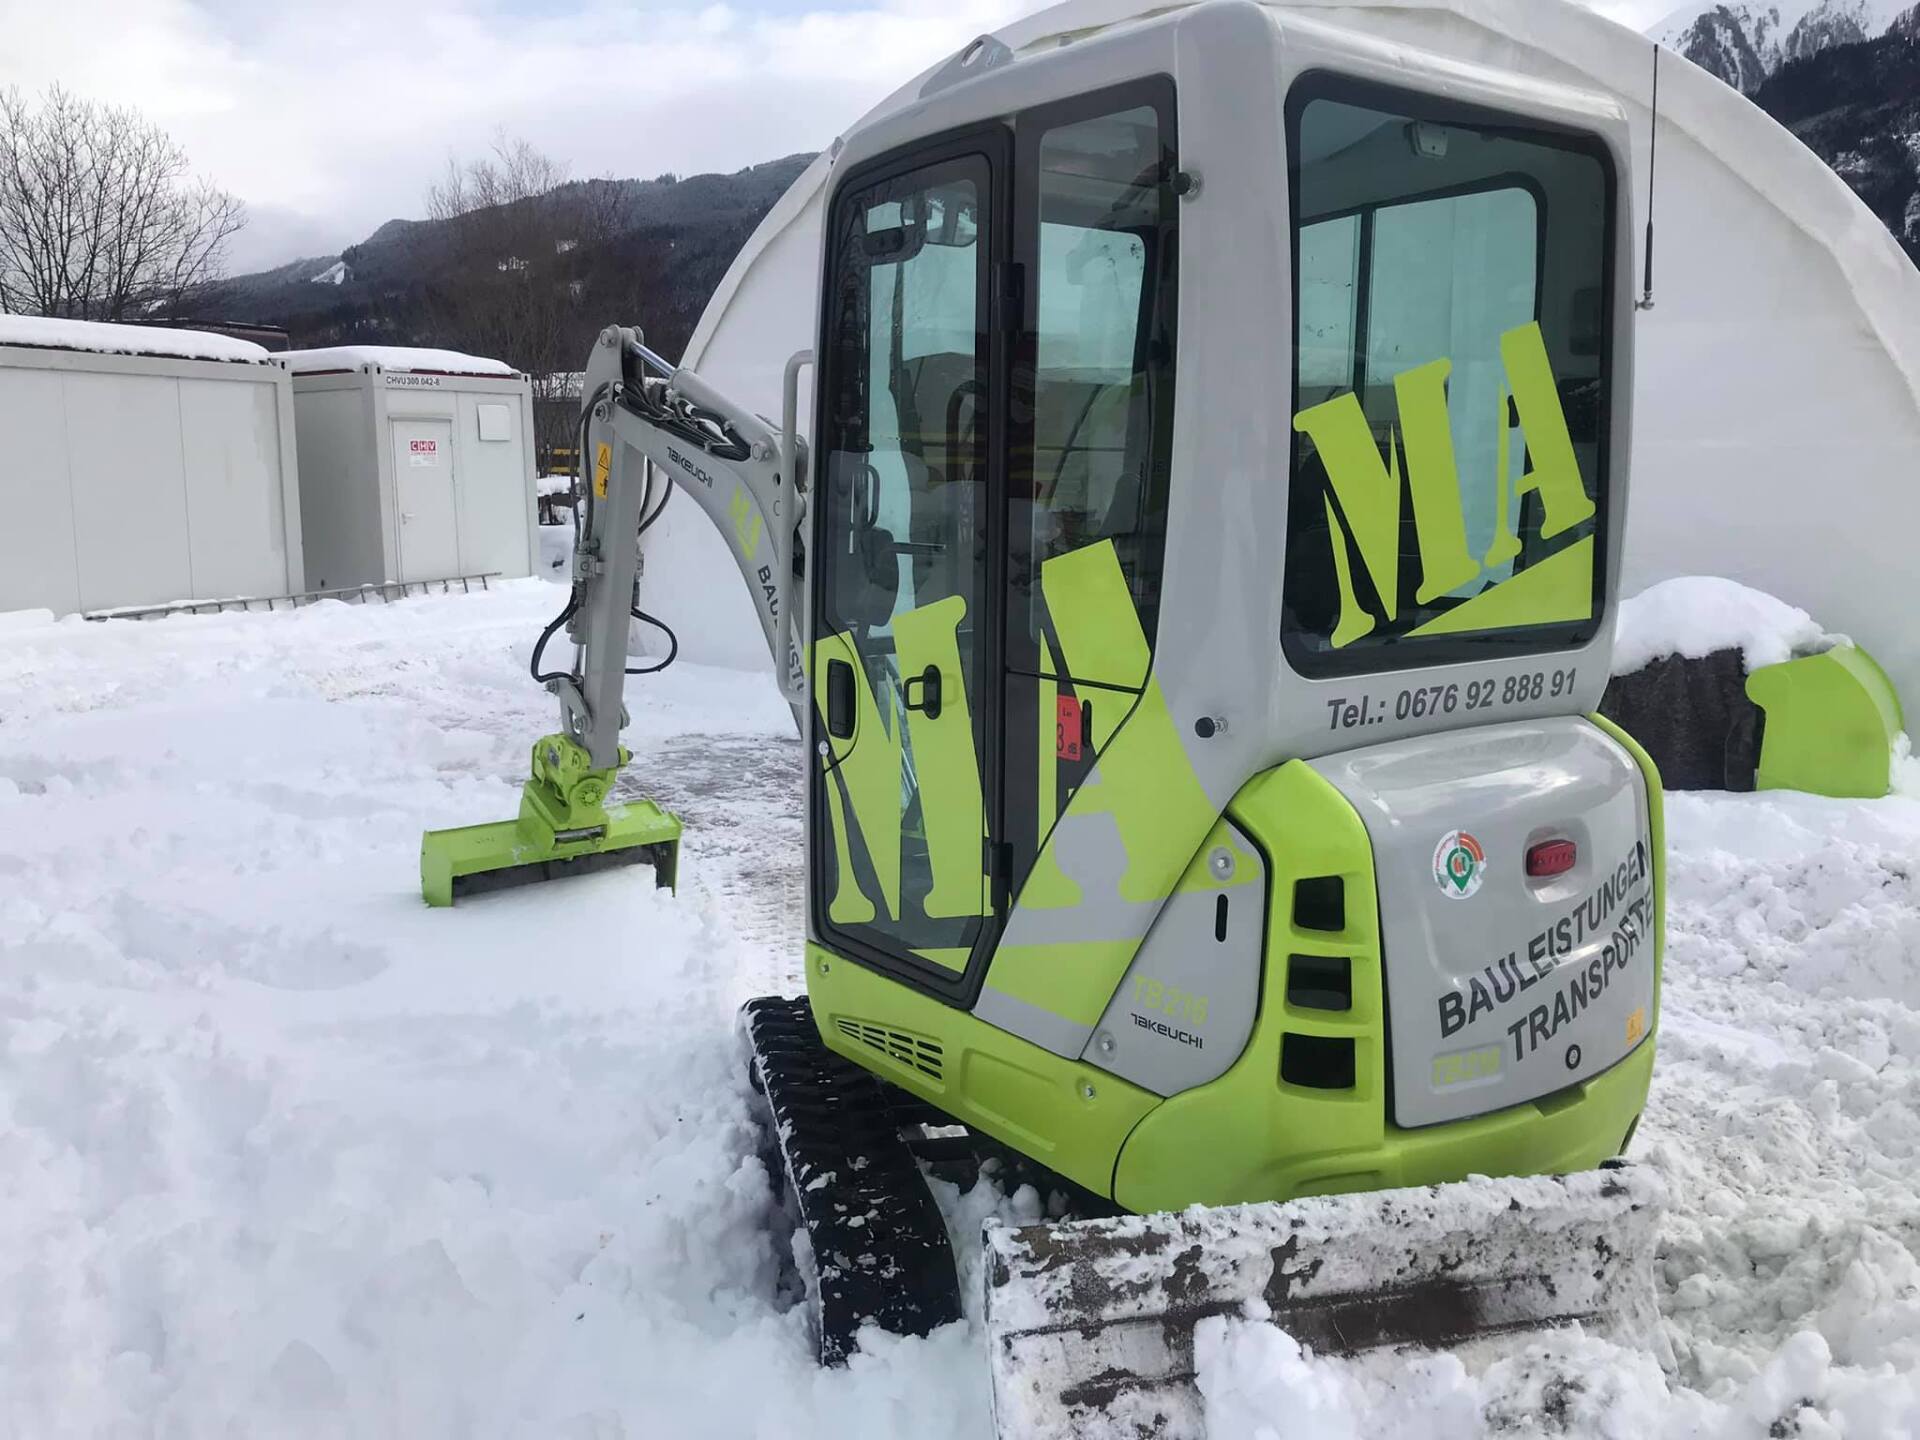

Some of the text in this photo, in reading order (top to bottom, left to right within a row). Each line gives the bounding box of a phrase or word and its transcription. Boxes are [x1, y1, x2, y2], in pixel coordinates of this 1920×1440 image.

[410, 440, 436, 451] CHV
[1293, 320, 1596, 648] MA
[1327, 667, 1577, 730] Tel.: 0676 92 888 91
[1438, 833, 1649, 1039] BAULEISTUNGEN
[1507, 885, 1653, 1062] TRANSPORTE
